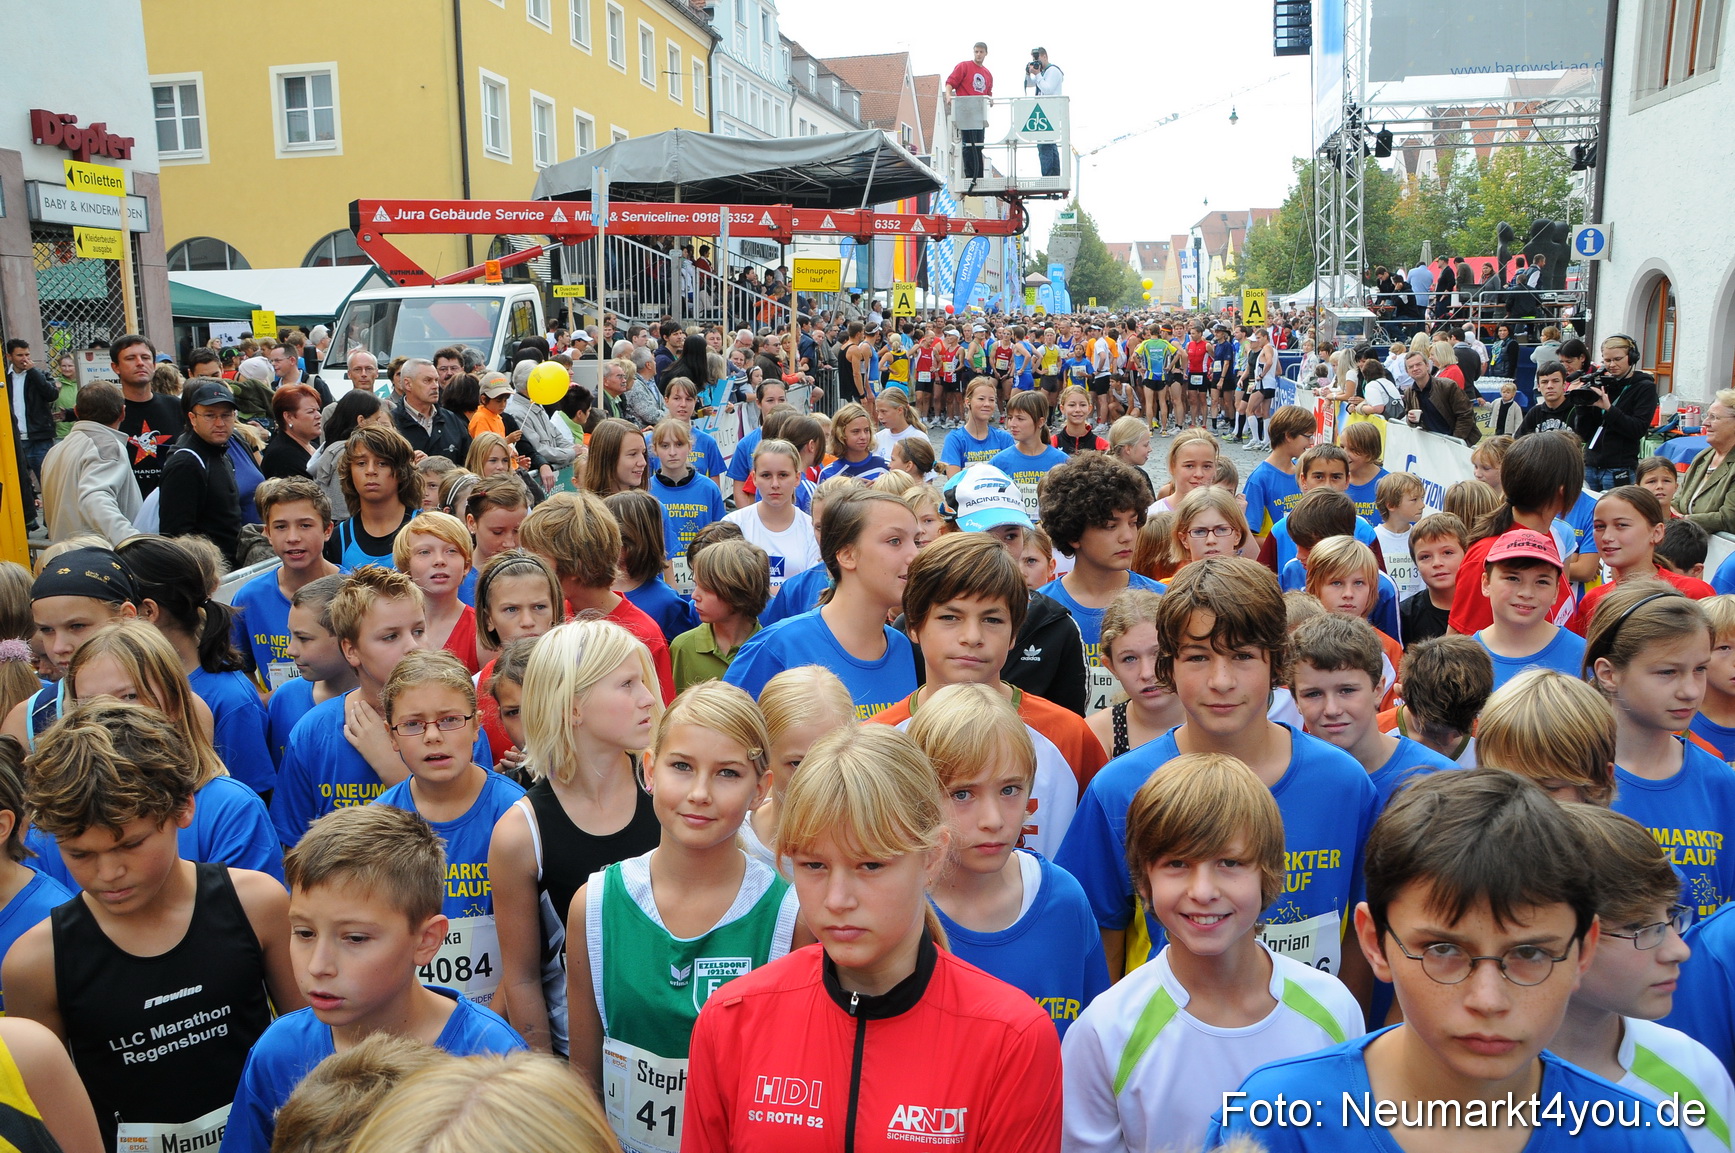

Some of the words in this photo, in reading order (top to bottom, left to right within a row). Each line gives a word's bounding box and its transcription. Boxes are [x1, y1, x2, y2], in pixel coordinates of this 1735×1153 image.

[30, 109, 134, 162] Döpfer
[76, 170, 123, 189] Toiletten
[44, 197, 67, 209] BABY
[70, 201, 77, 212] &
[80, 202, 143, 219] KINDERMDEN
[394, 208, 425, 221] Jura
[429, 208, 492, 220] Gebäude
[495, 208, 544, 221] Service
[609, 212, 618, 222] &
[621, 211, 689, 223] Serviceline:
[728, 213, 754, 223] 6352
[874, 219, 901, 229] 6352
[92, 244, 113, 255] ausgabe
[796, 267, 838, 276] Schnupper-
[897, 293, 911, 309] A
[1248, 300, 1262, 318] A
[965, 496, 1000, 508] RACING
[1390, 567, 1419, 578] 4013
[254, 634, 269, 644] 10.
[270, 647, 294, 659] STA
[1093, 673, 1112, 686] Leo
[441, 932, 461, 945] ka
[1260, 932, 1309, 952] lorian
[419, 953, 493, 983] 4084
[109, 1032, 146, 1051] LLC
[150, 1005, 231, 1040] Marathon
[123, 1023, 229, 1065] Regensburg
[608, 1082, 615, 1097] J
[754, 1075, 823, 1109] HDI
[748, 1110, 763, 1122] SC
[767, 1111, 802, 1126] ROTH
[806, 1115, 824, 1129] 52
[887, 1104, 968, 1133] ARNDT
[886, 1132, 965, 1145] SICHERHEITSDIENST
